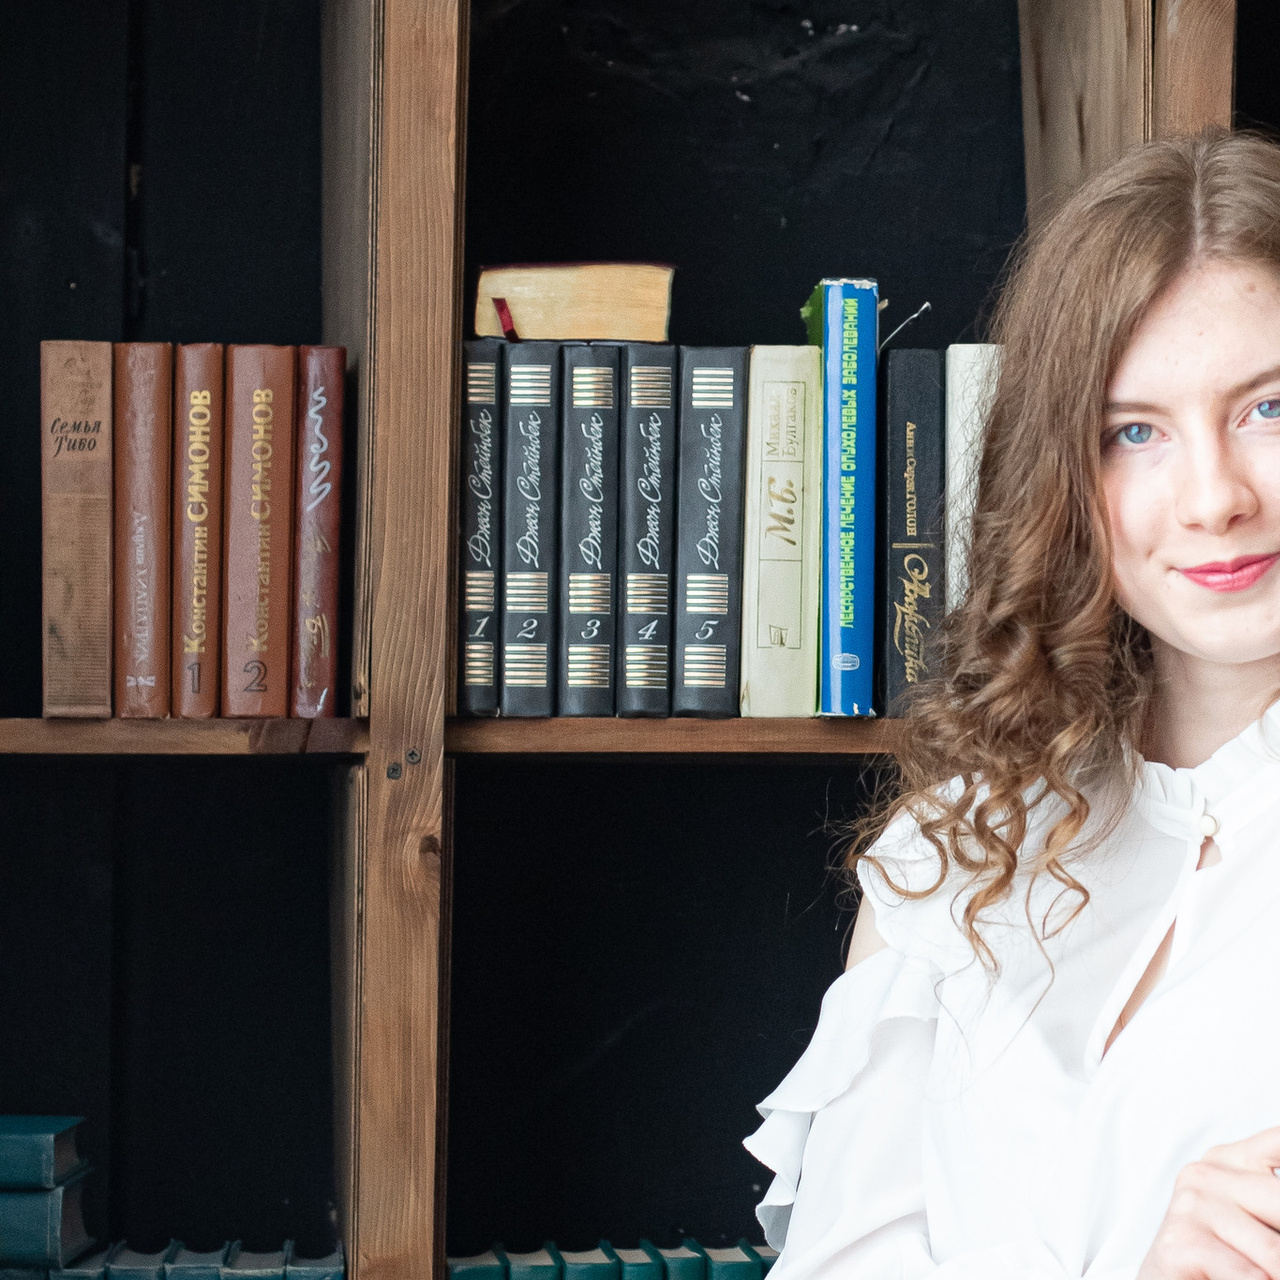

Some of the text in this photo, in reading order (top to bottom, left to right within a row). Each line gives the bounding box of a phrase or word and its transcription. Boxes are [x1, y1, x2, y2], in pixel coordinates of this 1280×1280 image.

[50, 416, 102, 438] Семья
[781, 386, 799, 459] Булгаков
[840, 389, 859, 473] ОПУХОЛЕВЫХ
[841, 297, 861, 387] ЗАБОЛЕВАНИЙ
[183, 388, 211, 693] 1 Константин СИМОНОВ
[243, 387, 273, 693] 2 Константин СИМОНОВ
[467, 410, 493, 639] 1 Джон Стейнбек
[516, 410, 542, 639] 2 Джон Стейнбек
[578, 410, 604, 639] 3 Джон Стейнбек
[636, 410, 662, 639] 4 Джон Стейнбек
[695, 410, 723, 639] 5 Джон Стейнбек
[839, 475, 858, 531] ЛЕЧЕНИЕ
[905, 491, 917, 537] ГОЛОН
